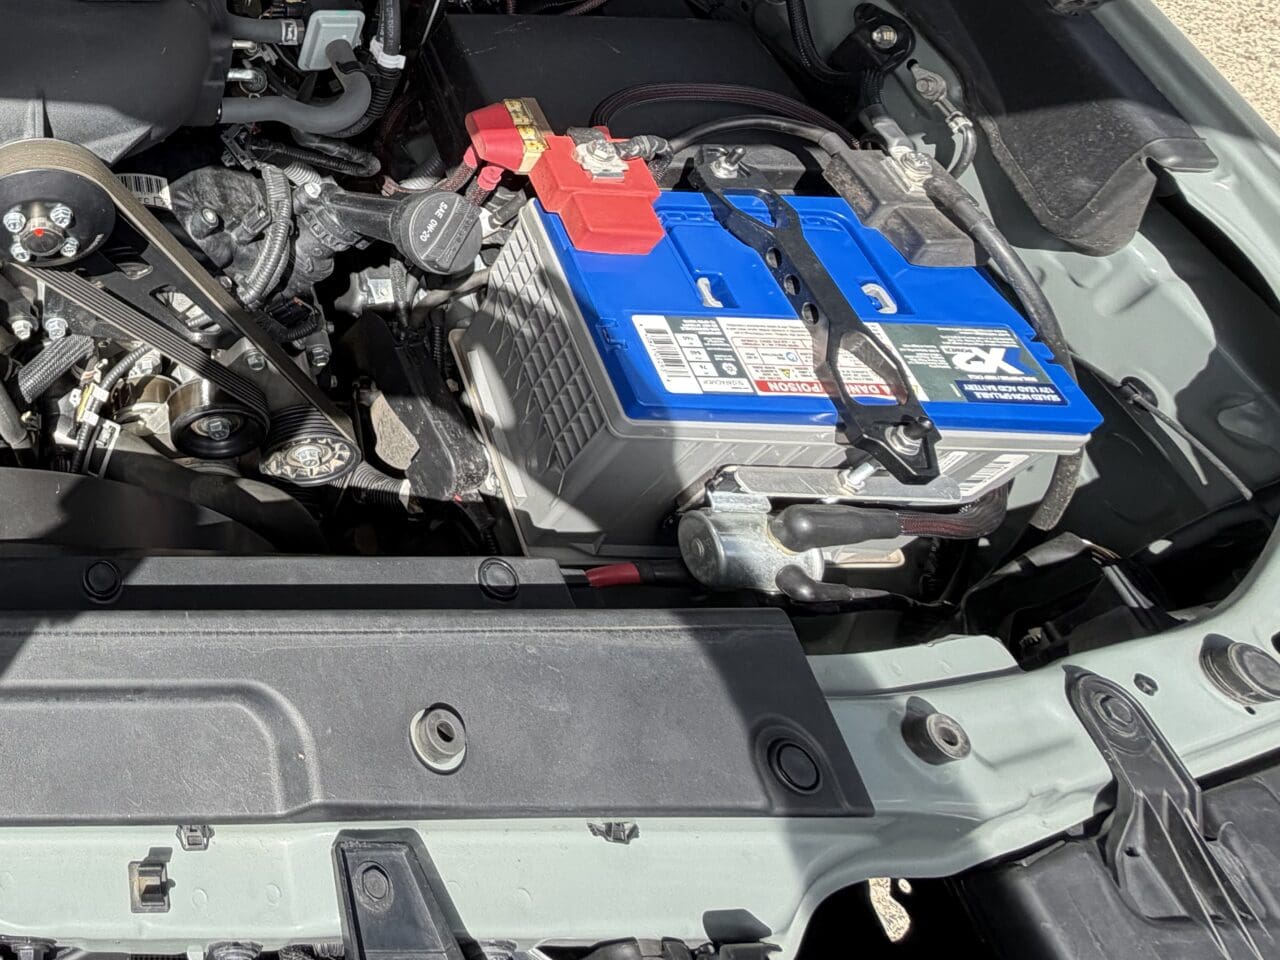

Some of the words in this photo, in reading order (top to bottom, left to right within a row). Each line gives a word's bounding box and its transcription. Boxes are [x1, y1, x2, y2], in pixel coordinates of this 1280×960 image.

[434, 201, 448, 220] SAE
[419, 219, 438, 242] 0W-20
[767, 381, 819, 393] POISON
[963, 383, 998, 392] BATTERY
[1018, 385, 1038, 393] LEAD
